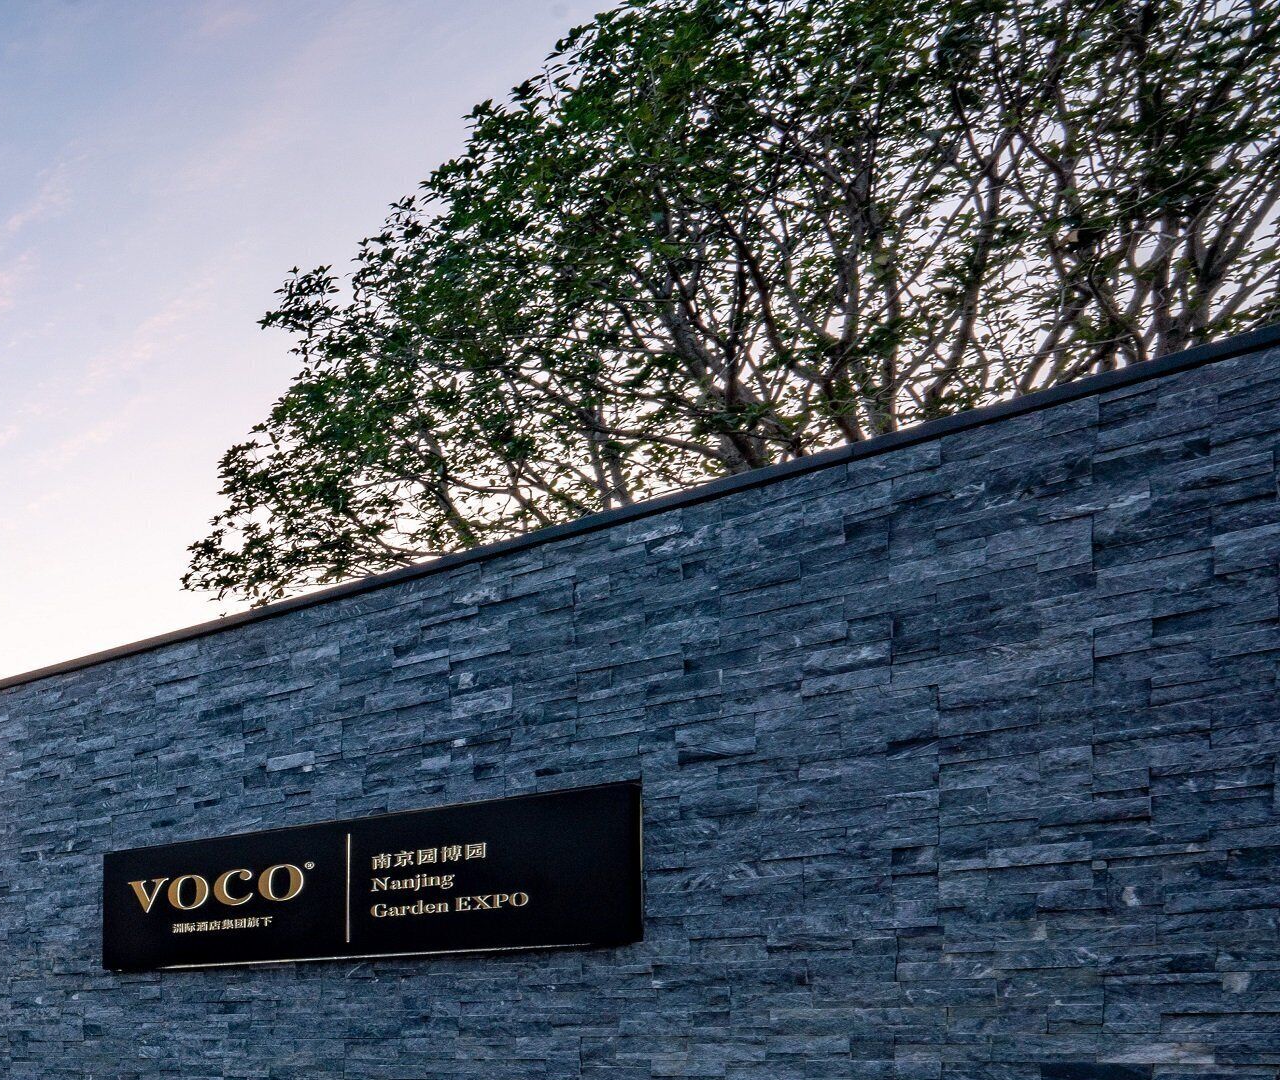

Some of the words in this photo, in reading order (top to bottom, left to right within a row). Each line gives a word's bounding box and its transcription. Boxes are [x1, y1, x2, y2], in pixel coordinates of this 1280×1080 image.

[371, 842, 487, 870] 南京园博园
[370, 873, 456, 892] Nanjing
[370, 900, 449, 918] Garden
[455, 892, 529, 912] EXPO
[172, 916, 273, 934] 洲际酒店集团旗下
